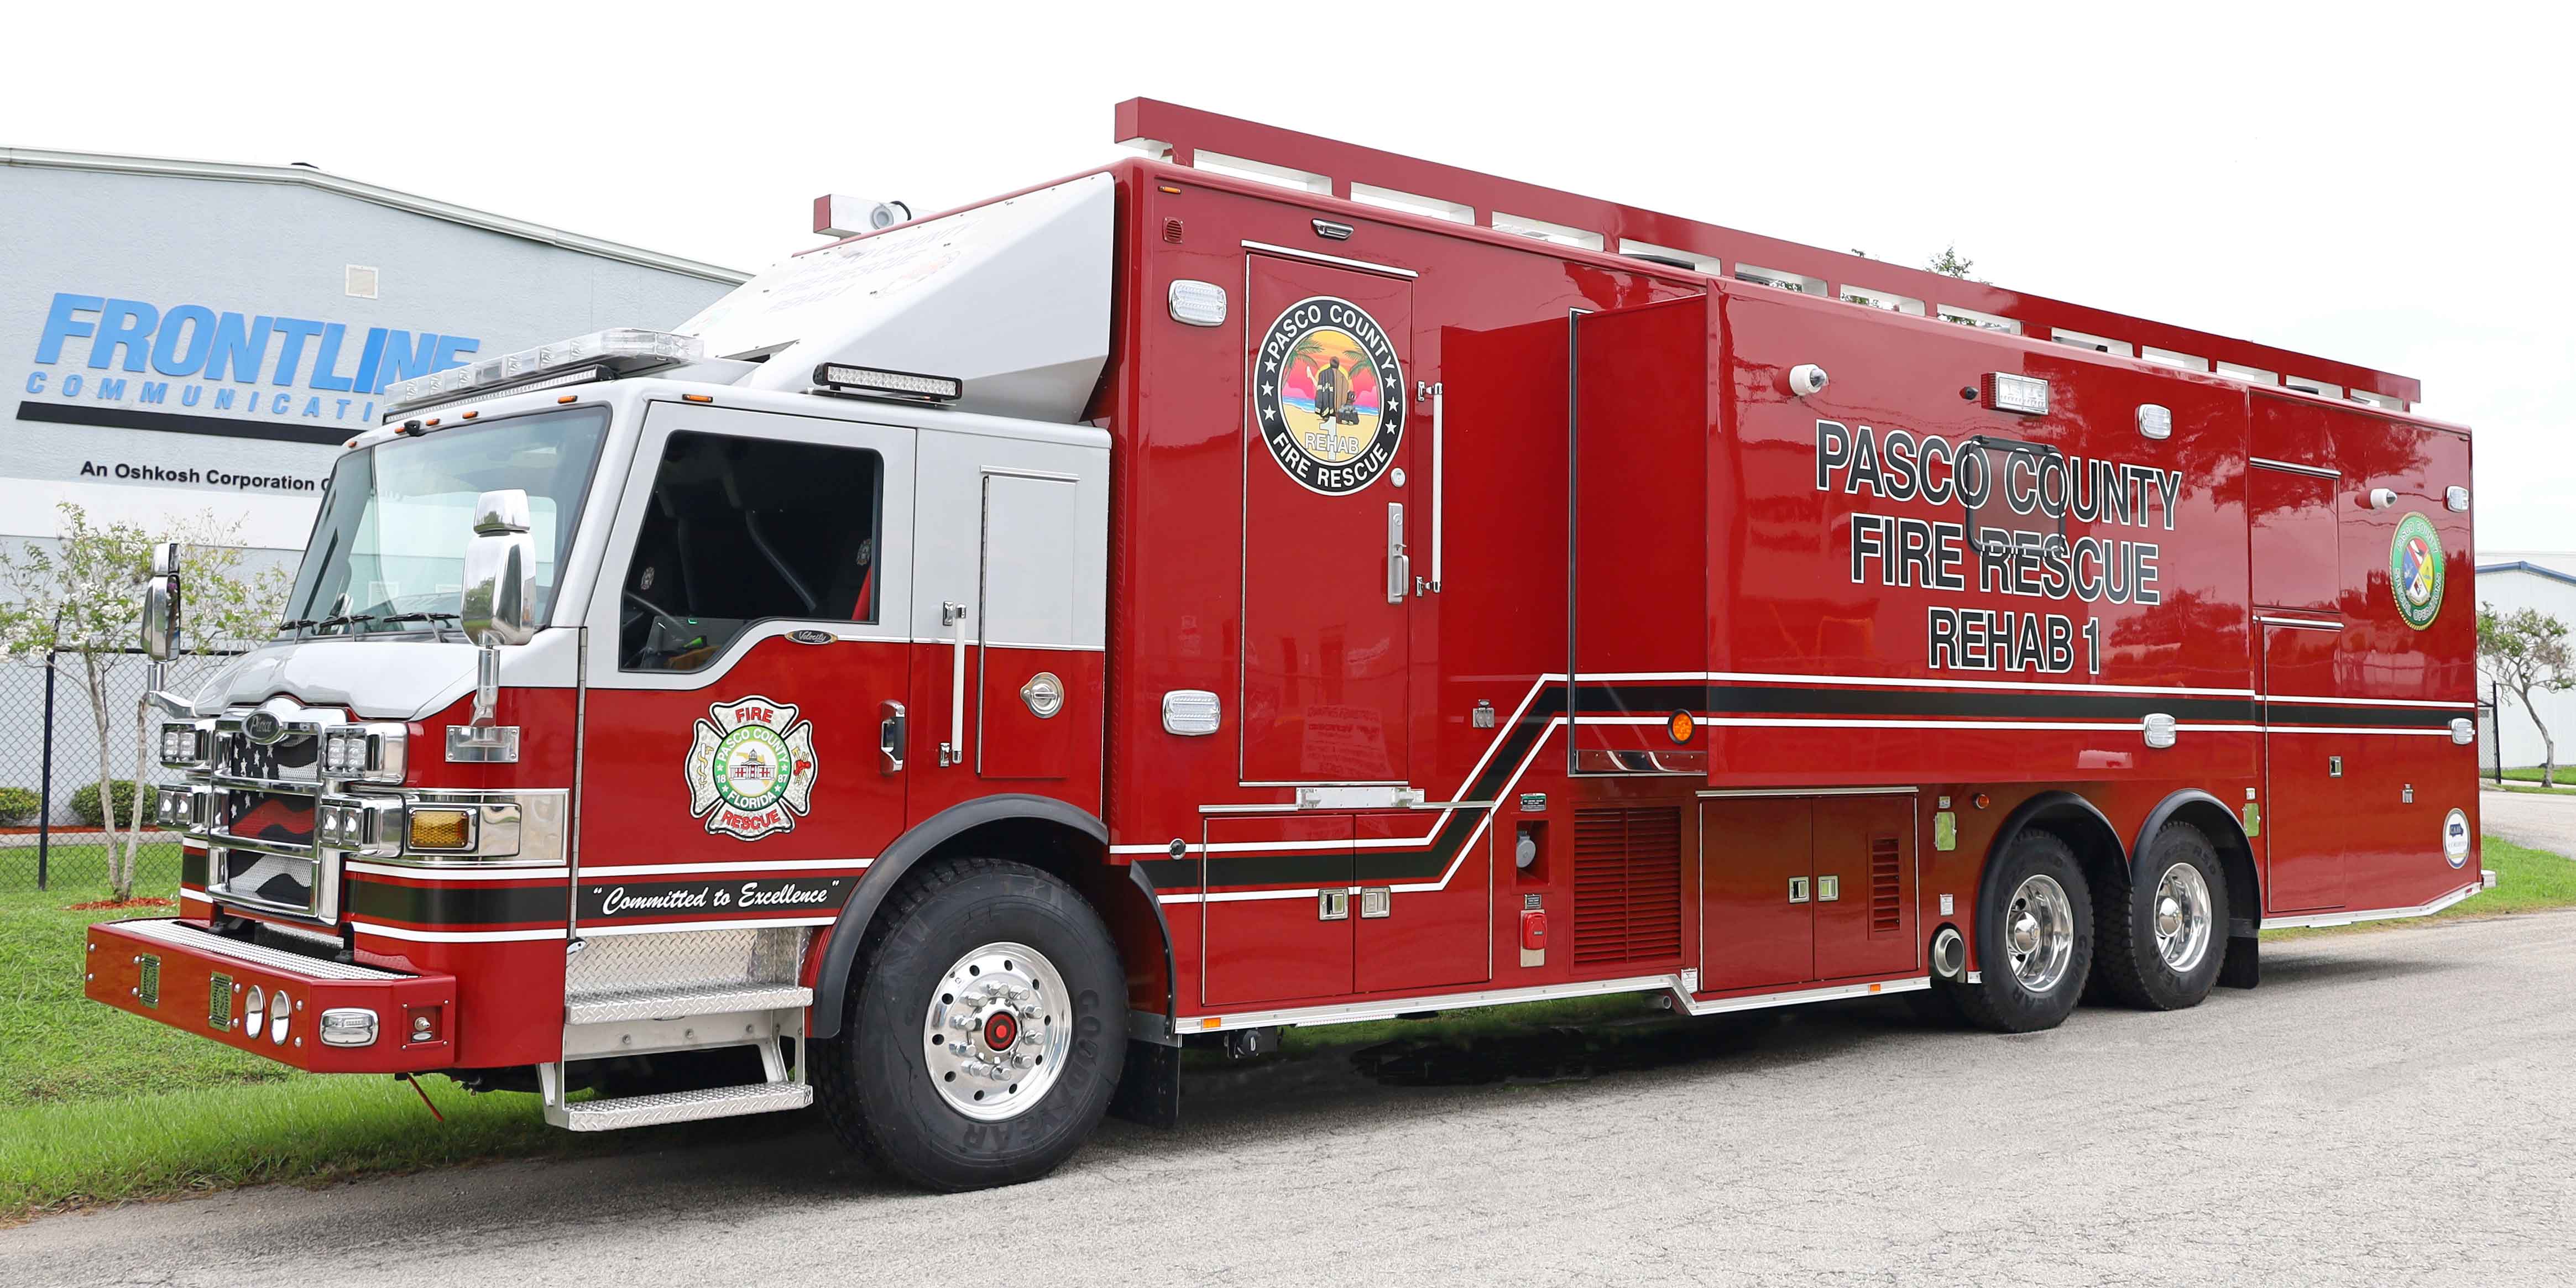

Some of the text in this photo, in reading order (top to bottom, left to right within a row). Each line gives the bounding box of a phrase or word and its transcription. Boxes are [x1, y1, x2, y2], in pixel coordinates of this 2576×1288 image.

[1267, 304, 1395, 370] PASCO COUNTY
[25, 371, 376, 422] COMMUNICATI
[1304, 432, 1360, 454] REHAB
[1320, 416, 1337, 461] 1
[80, 460, 108, 477] An
[114, 463, 201, 484] Oshkosh
[206, 469, 315, 491] Corporation
[1273, 432, 1389, 488] FIRE RESCUE
[1816, 419, 2183, 531] PASCO COUNTY
[1850, 512, 2160, 606] FIRE RESCUE
[798, 631, 827, 642] Velocity
[1928, 606, 2100, 675] REHAB 1
[735, 707, 774, 723] FIRE
[718, 729, 789, 763] PASCO COUNTY
[716, 774, 787, 783] 18 87
[727, 790, 777, 809] FLORIDA
[721, 809, 781, 829] RESCUE
[712, 889, 731, 907] to
